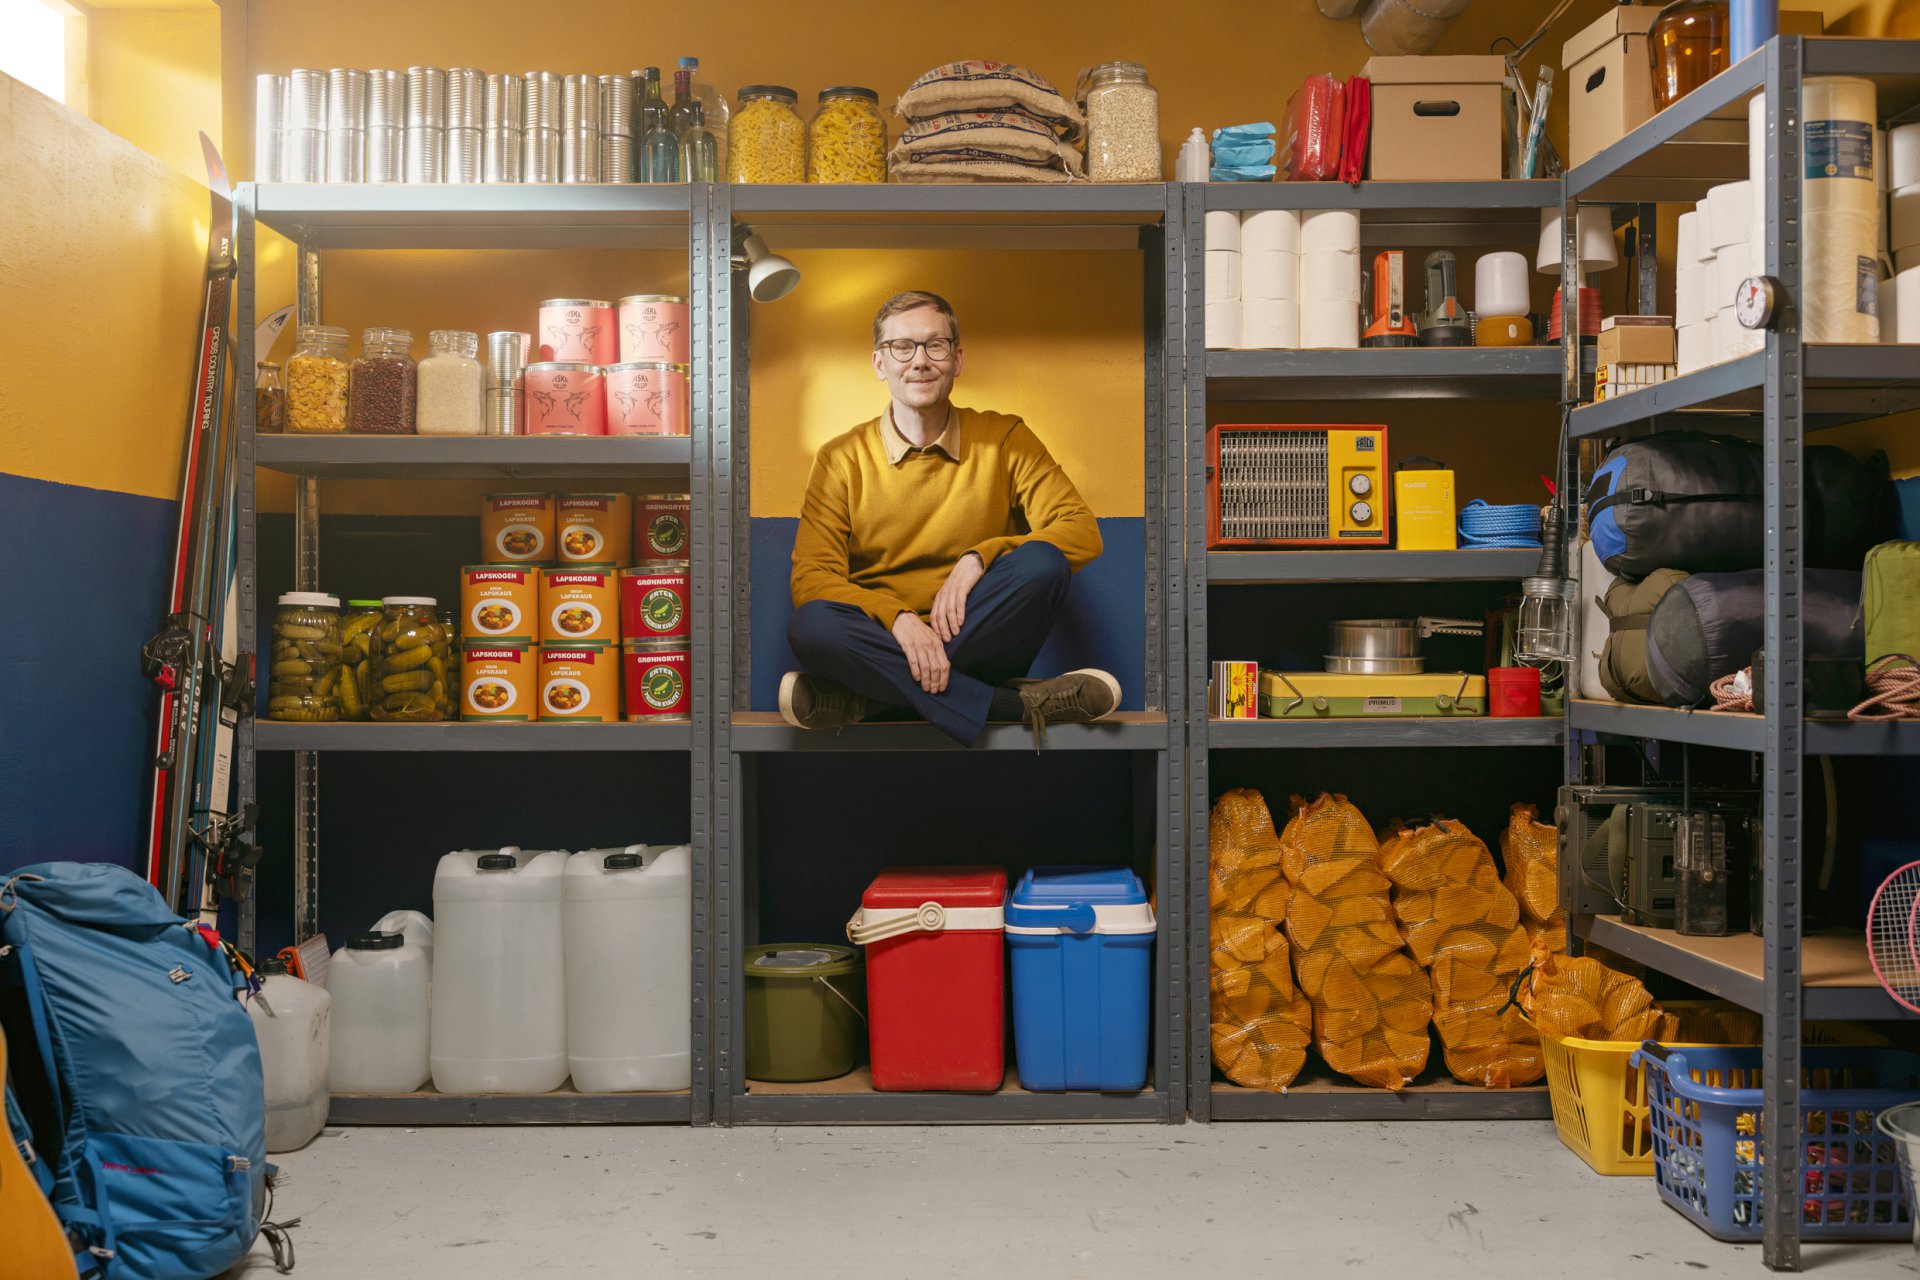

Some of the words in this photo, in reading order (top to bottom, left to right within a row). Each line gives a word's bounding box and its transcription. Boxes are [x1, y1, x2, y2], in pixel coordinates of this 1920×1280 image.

[210, 326, 220, 354] CROSS
[205, 355, 218, 393] COUNTRY
[202, 393, 212, 430] TOURING
[650, 590, 674, 600] ERTER
[650, 667, 674, 678] ERTER
[181, 667, 193, 730] ATOMI
[191, 660, 203, 735] ATOMIC
